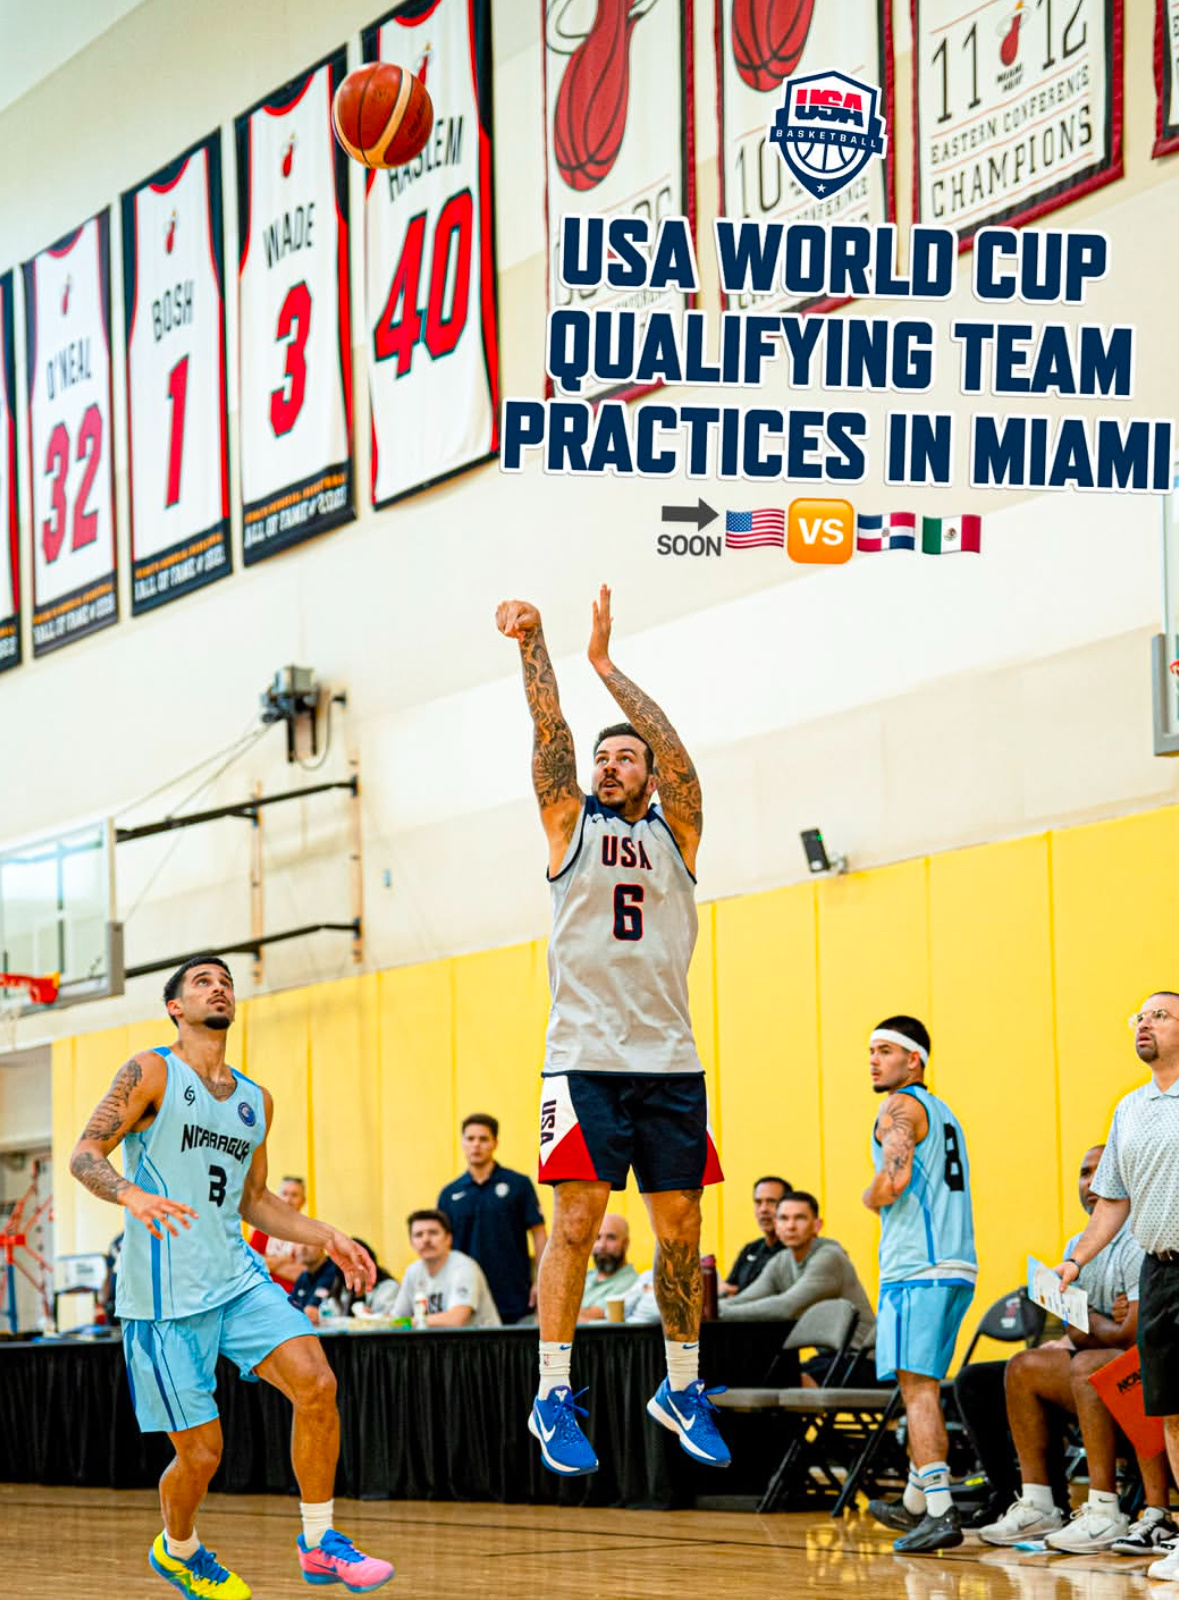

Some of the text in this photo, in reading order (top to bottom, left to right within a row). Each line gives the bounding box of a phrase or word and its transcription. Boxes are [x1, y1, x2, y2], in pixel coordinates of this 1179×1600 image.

[931, 65, 1089, 164] EASTERN CONFERENCE
[932, 104, 1092, 218] CHAMPIONS
[263, 201, 316, 268] WADE
[151, 280, 195, 342] BOSH
[373, 186, 473, 379] 40
[47, 336, 92, 400] O'NEAL
[269, 279, 312, 437] 3
[165, 353, 190, 509] 1
[42, 402, 102, 565] 32
[602, 835, 653, 870] USA
[613, 883, 645, 941] 6
[540, 1099, 557, 1146] USA
[208, 1164, 227, 1208] 3
[943, 1122, 965, 1192] 8
[1117, 1369, 1142, 1393] NCA
